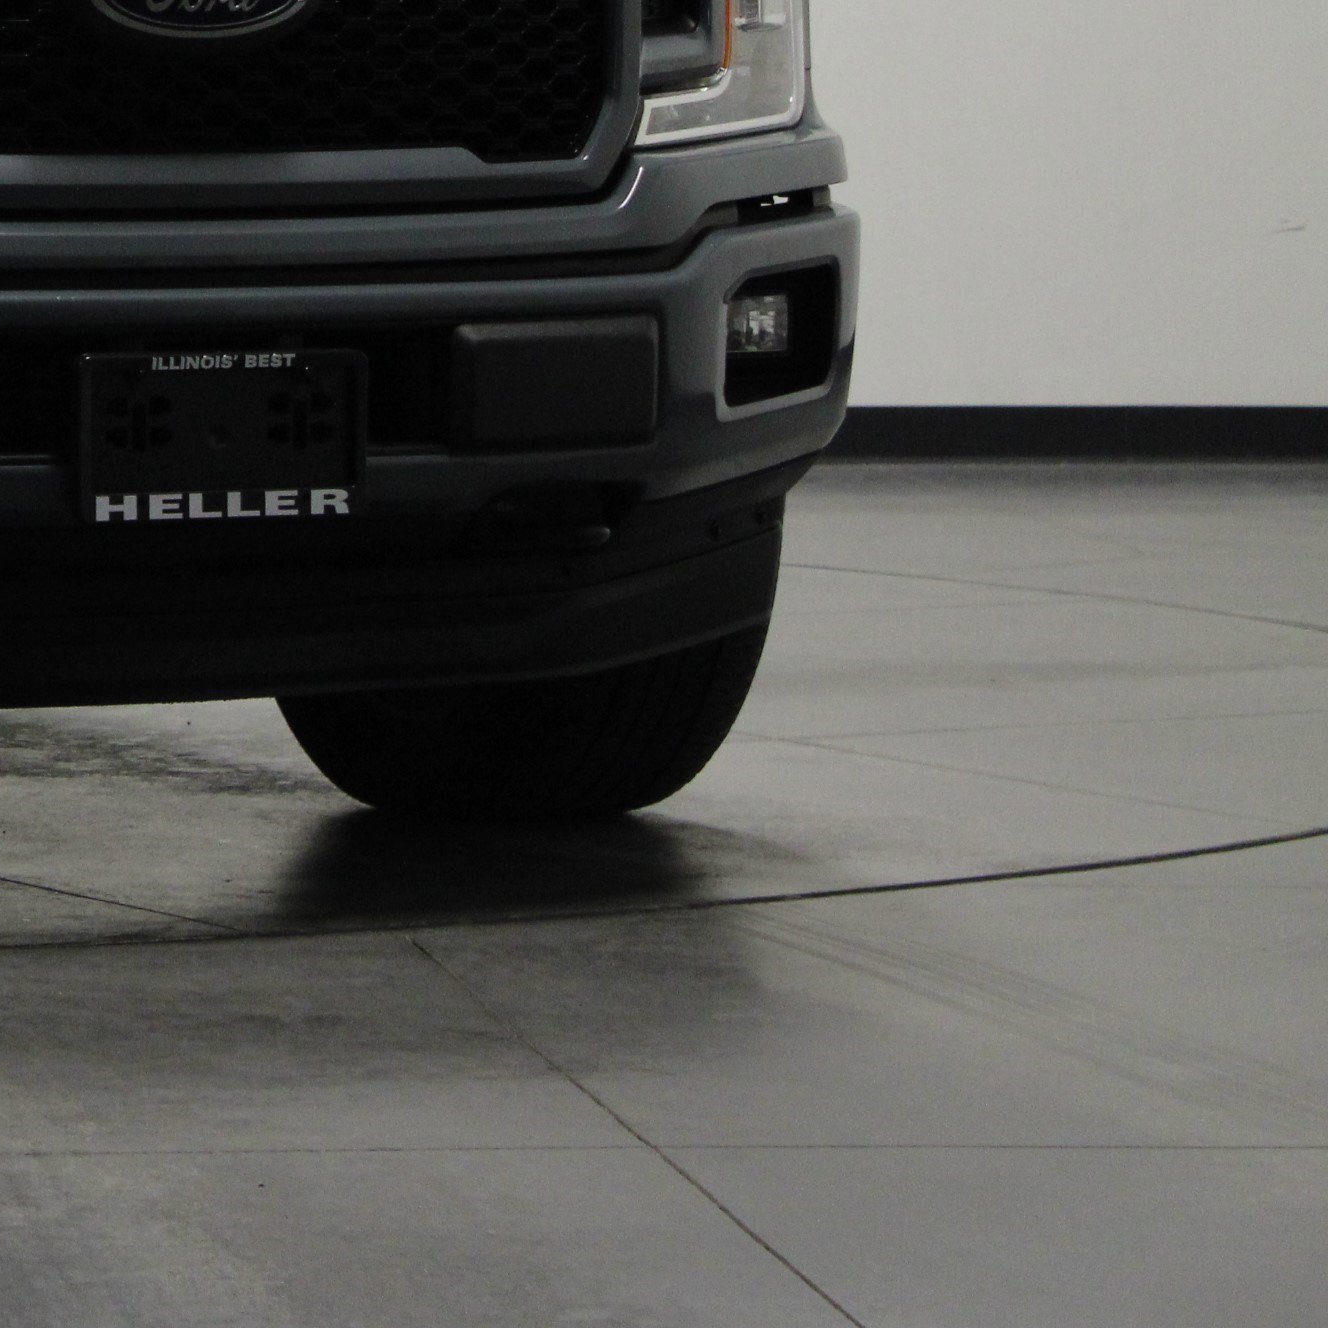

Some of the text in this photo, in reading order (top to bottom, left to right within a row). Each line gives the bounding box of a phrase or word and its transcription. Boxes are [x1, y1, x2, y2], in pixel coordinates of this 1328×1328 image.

[151, 353, 296, 371] ILLINOIS' BEST
[95, 488, 350, 522] HELLER
